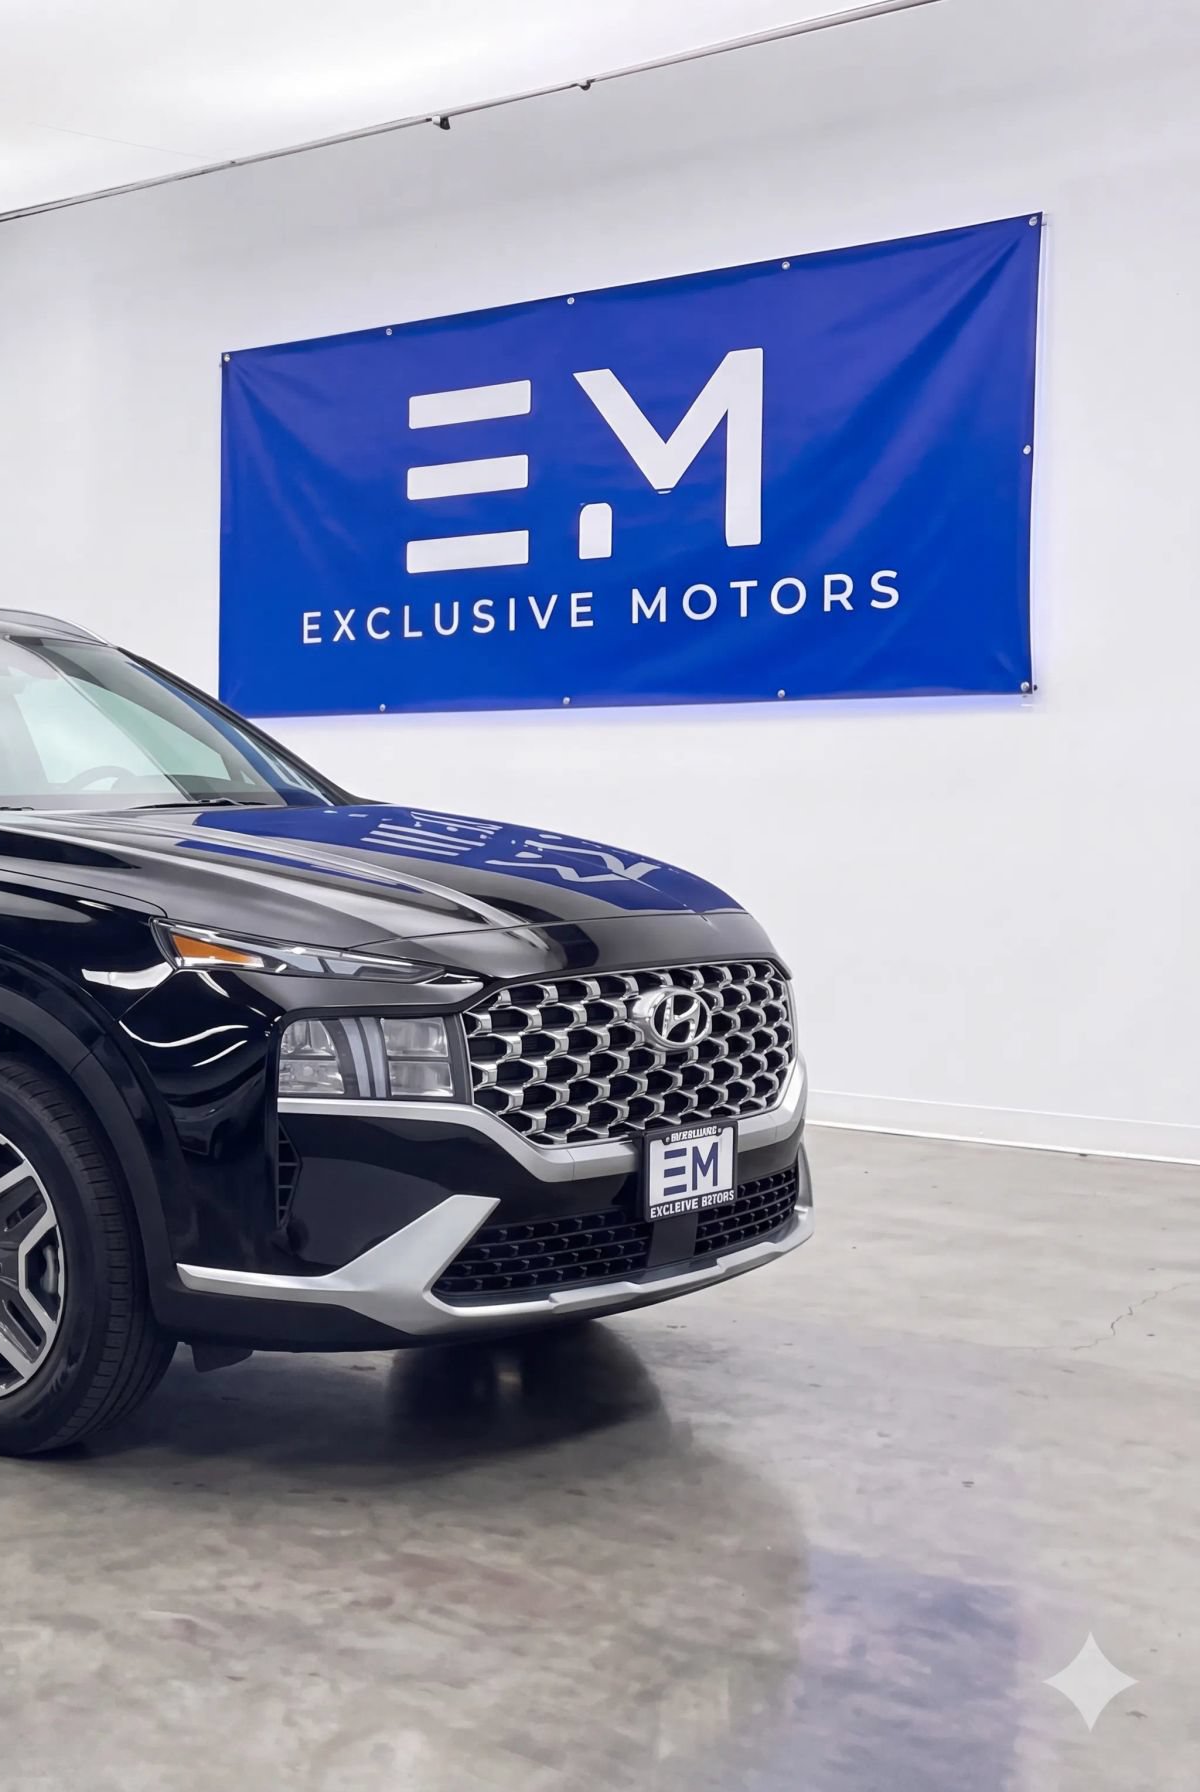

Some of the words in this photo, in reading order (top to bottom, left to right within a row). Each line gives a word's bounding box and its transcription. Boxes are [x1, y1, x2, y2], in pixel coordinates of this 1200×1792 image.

[407, 347, 764, 574] EM
[302, 591, 594, 644] EXCLUSIVE
[631, 569, 899, 624] MOTORS
[663, 1141, 719, 1197] EM
